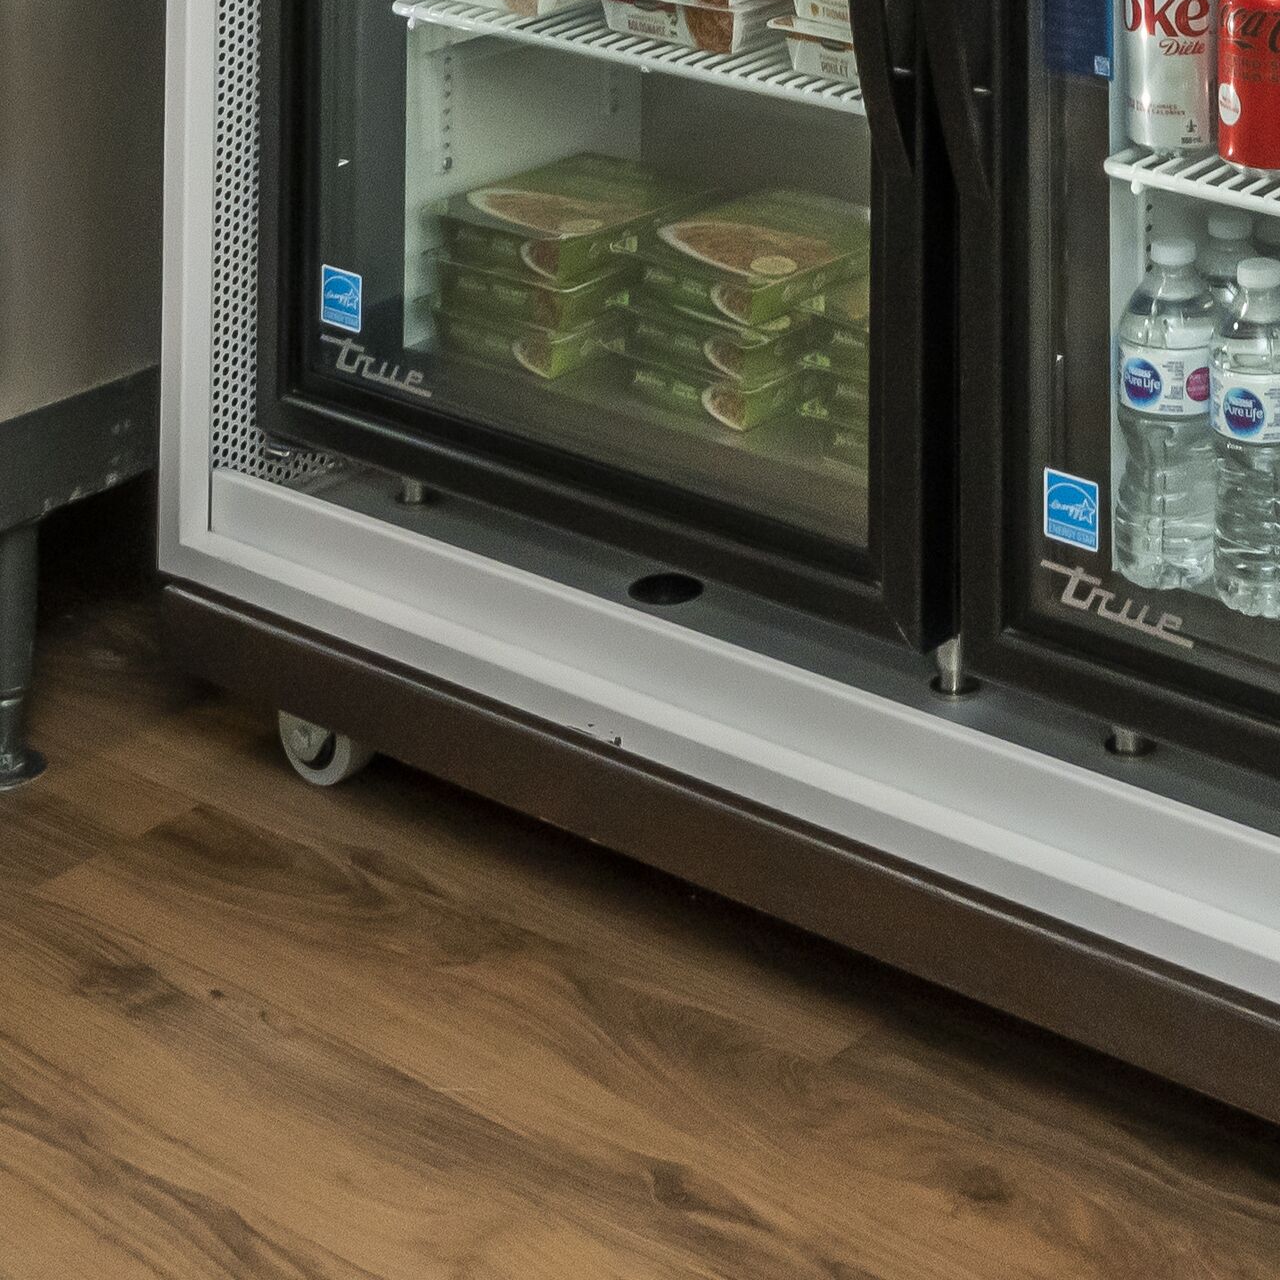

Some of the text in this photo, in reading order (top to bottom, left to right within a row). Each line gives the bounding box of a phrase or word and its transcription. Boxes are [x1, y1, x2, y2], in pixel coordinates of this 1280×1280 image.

[1124, 373, 1161, 394] Pure Life
[1225, 402, 1264, 423] Pure Life
